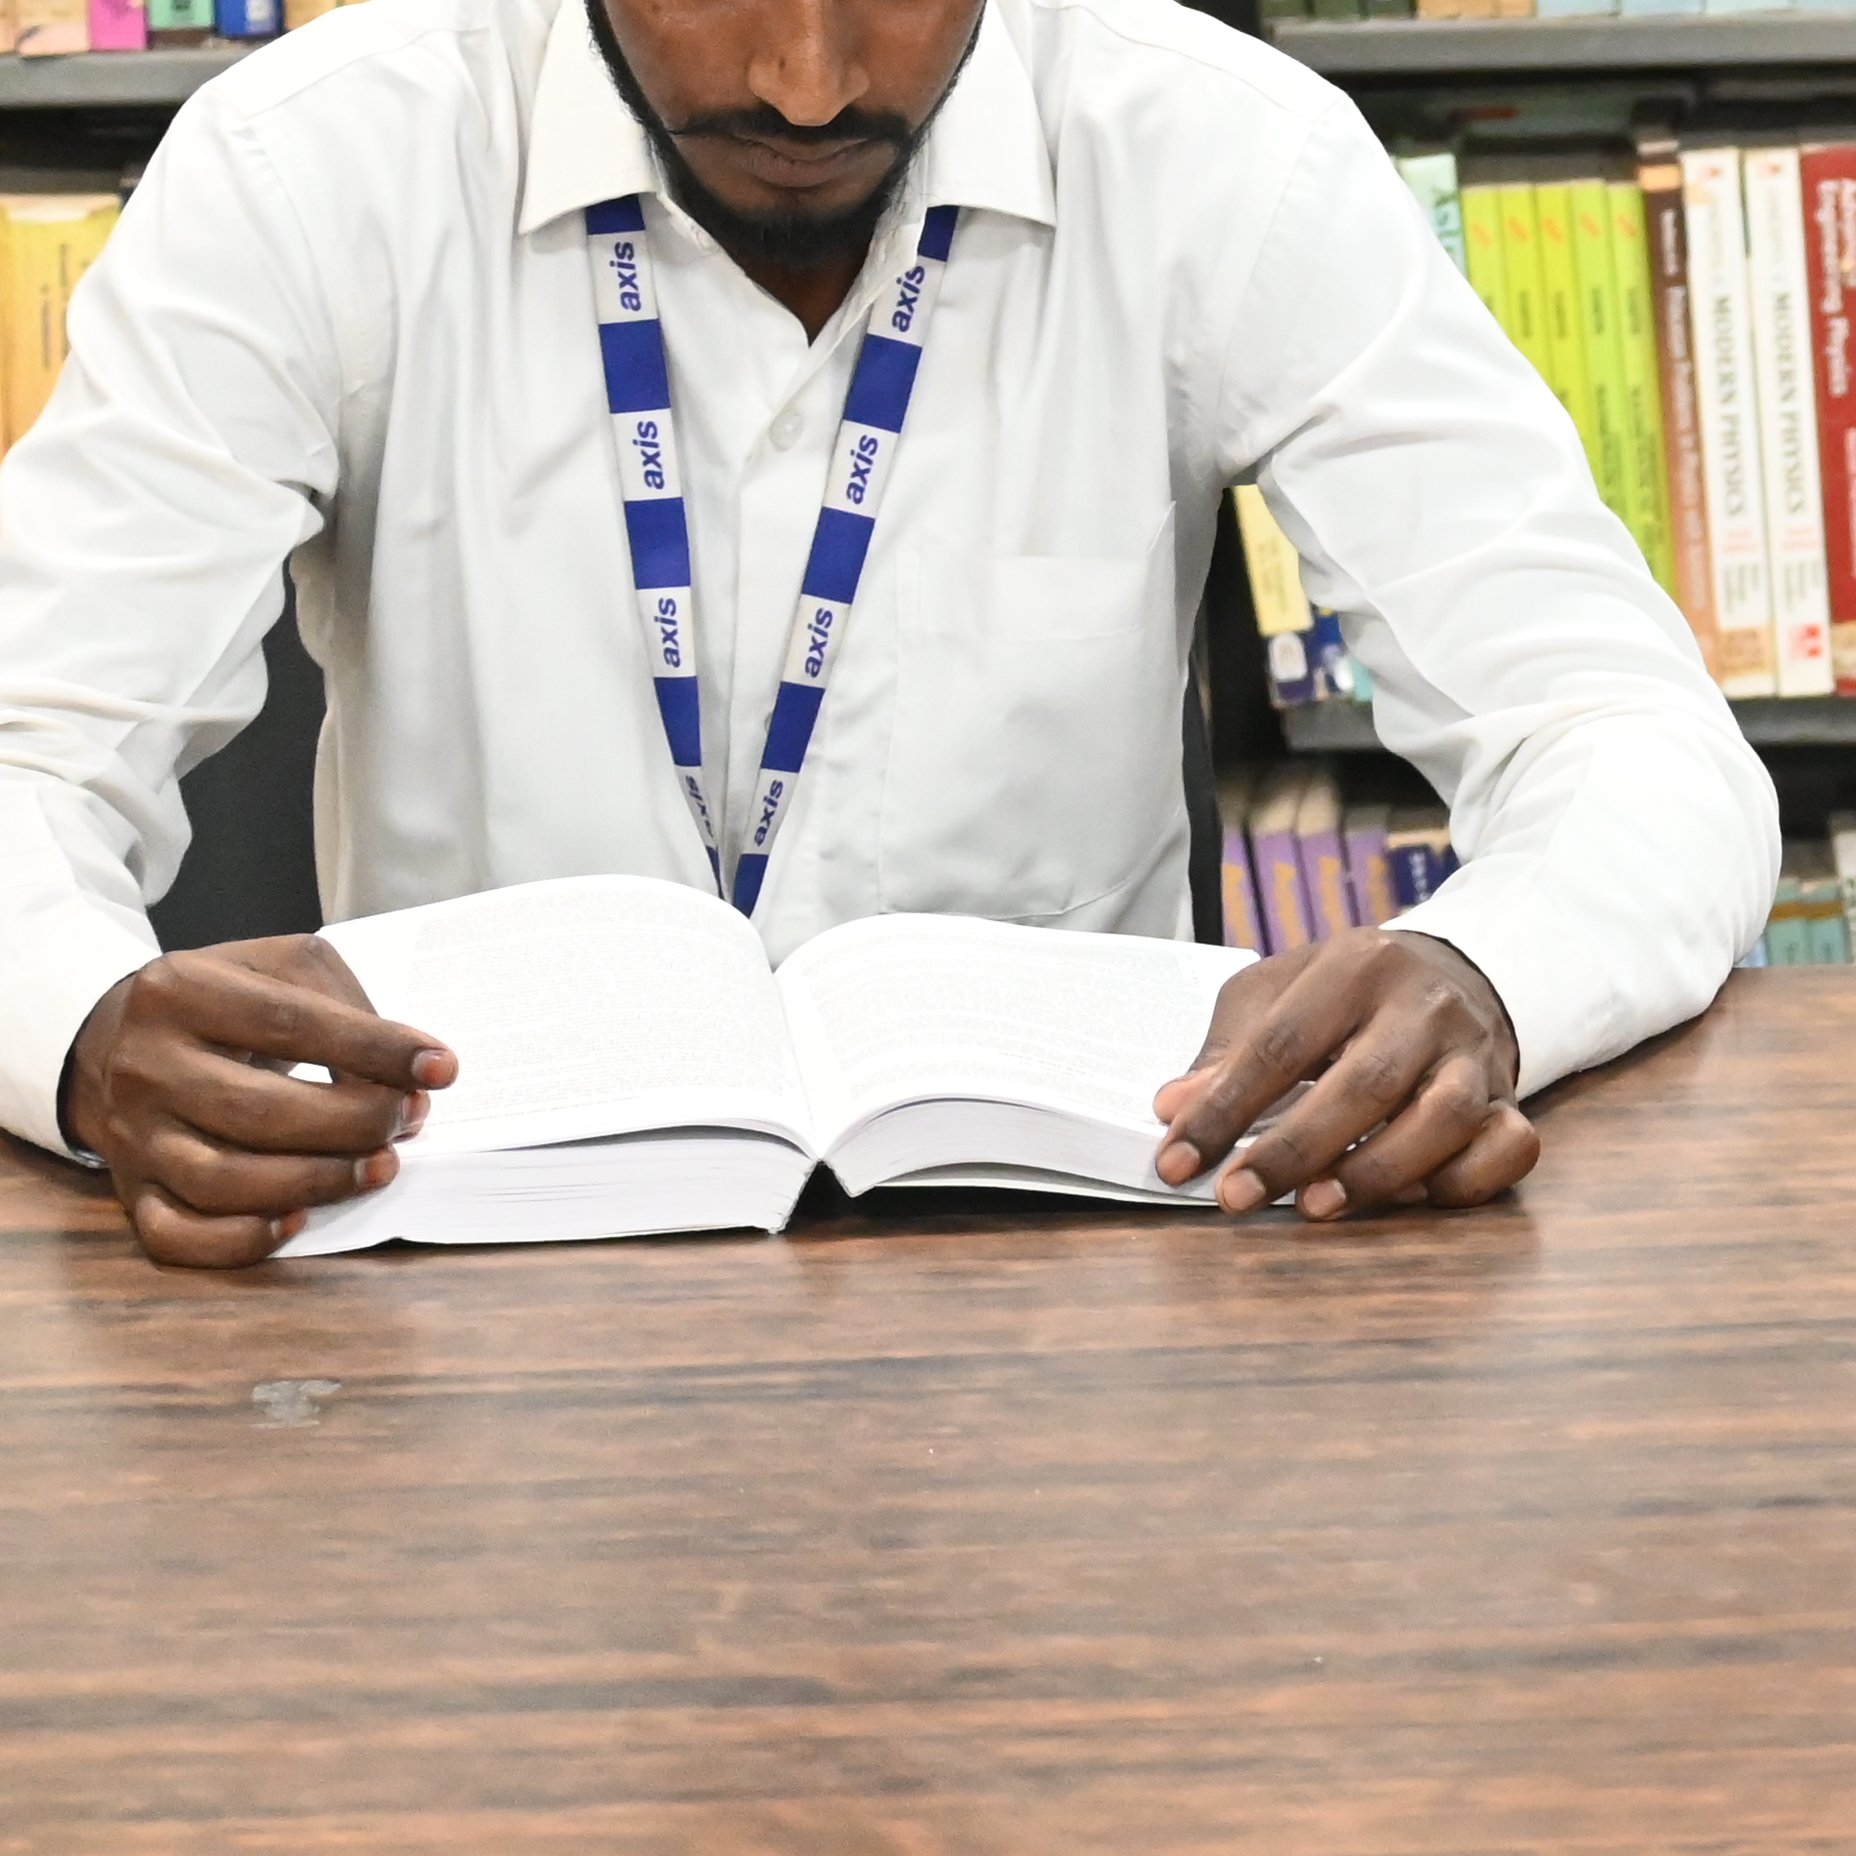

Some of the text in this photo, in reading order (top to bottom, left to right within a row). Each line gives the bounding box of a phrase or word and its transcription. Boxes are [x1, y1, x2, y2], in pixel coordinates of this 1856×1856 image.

[609, 240, 642, 312] axis
[891, 262, 926, 333] axis
[1816, 181, 1850, 394] Engineering Physics
[1712, 296, 1745, 516] MODERN PHYSICS
[1771, 291, 1805, 512] MODERN PHYSICS
[632, 419, 667, 491] axis
[845, 432, 879, 505] axis
[654, 596, 682, 669] axis
[803, 606, 834, 679] axis
[754, 778, 785, 848] axis
